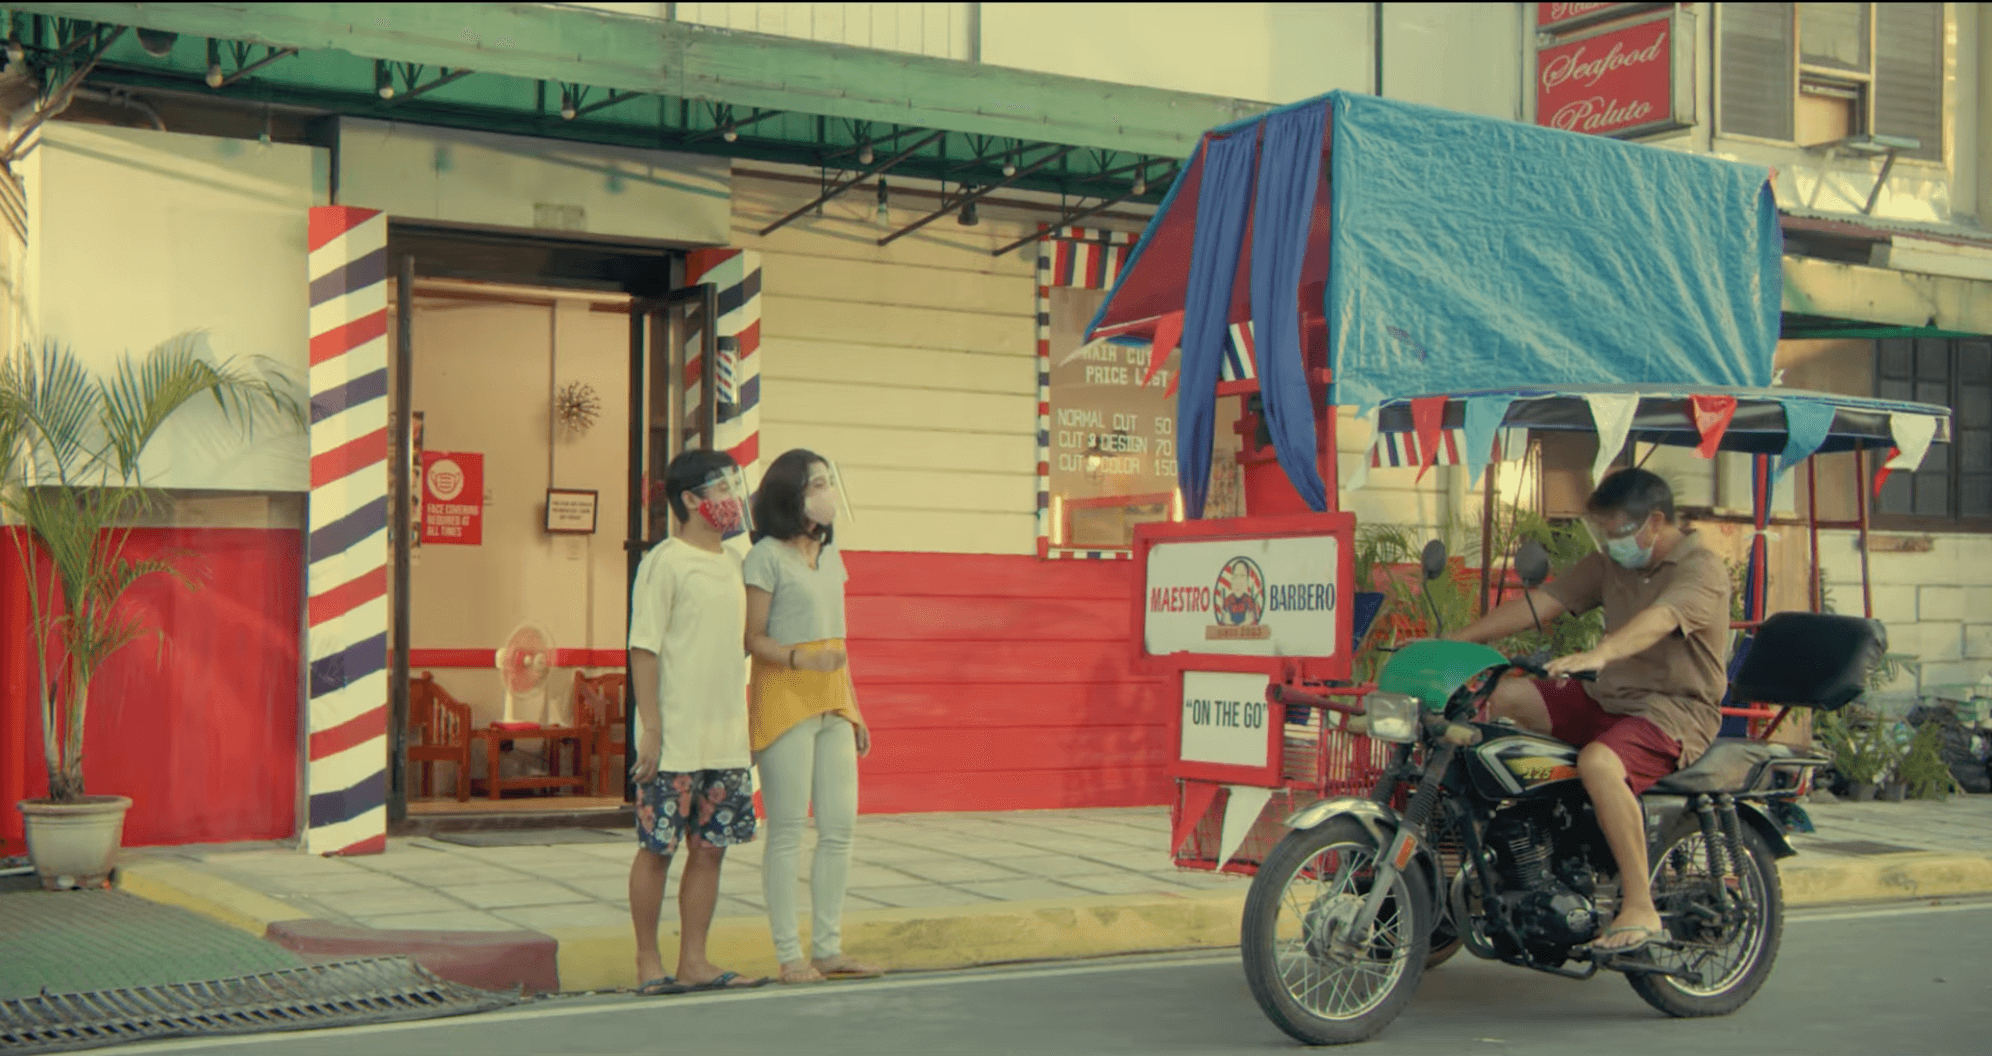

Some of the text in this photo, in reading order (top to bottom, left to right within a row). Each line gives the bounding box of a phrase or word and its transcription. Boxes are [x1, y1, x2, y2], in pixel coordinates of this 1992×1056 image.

[1542, 32, 1666, 94] Seafood
[1550, 96, 1653, 131] Paluto
[1085, 365, 1128, 385] PRICE
[1056, 408, 1171, 435] NORMAL CUT 50
[1058, 430, 1084, 448] CUT
[1100, 433, 1148, 454] DESIGN
[1155, 438, 1171, 457] 70
[1058, 453, 1084, 472] CUT
[1154, 459, 1178, 476] 150
[427, 503, 444, 514] FACE
[1151, 582, 1335, 613] MAESTRO BARBERO
[1214, 700, 1241, 728] THE
